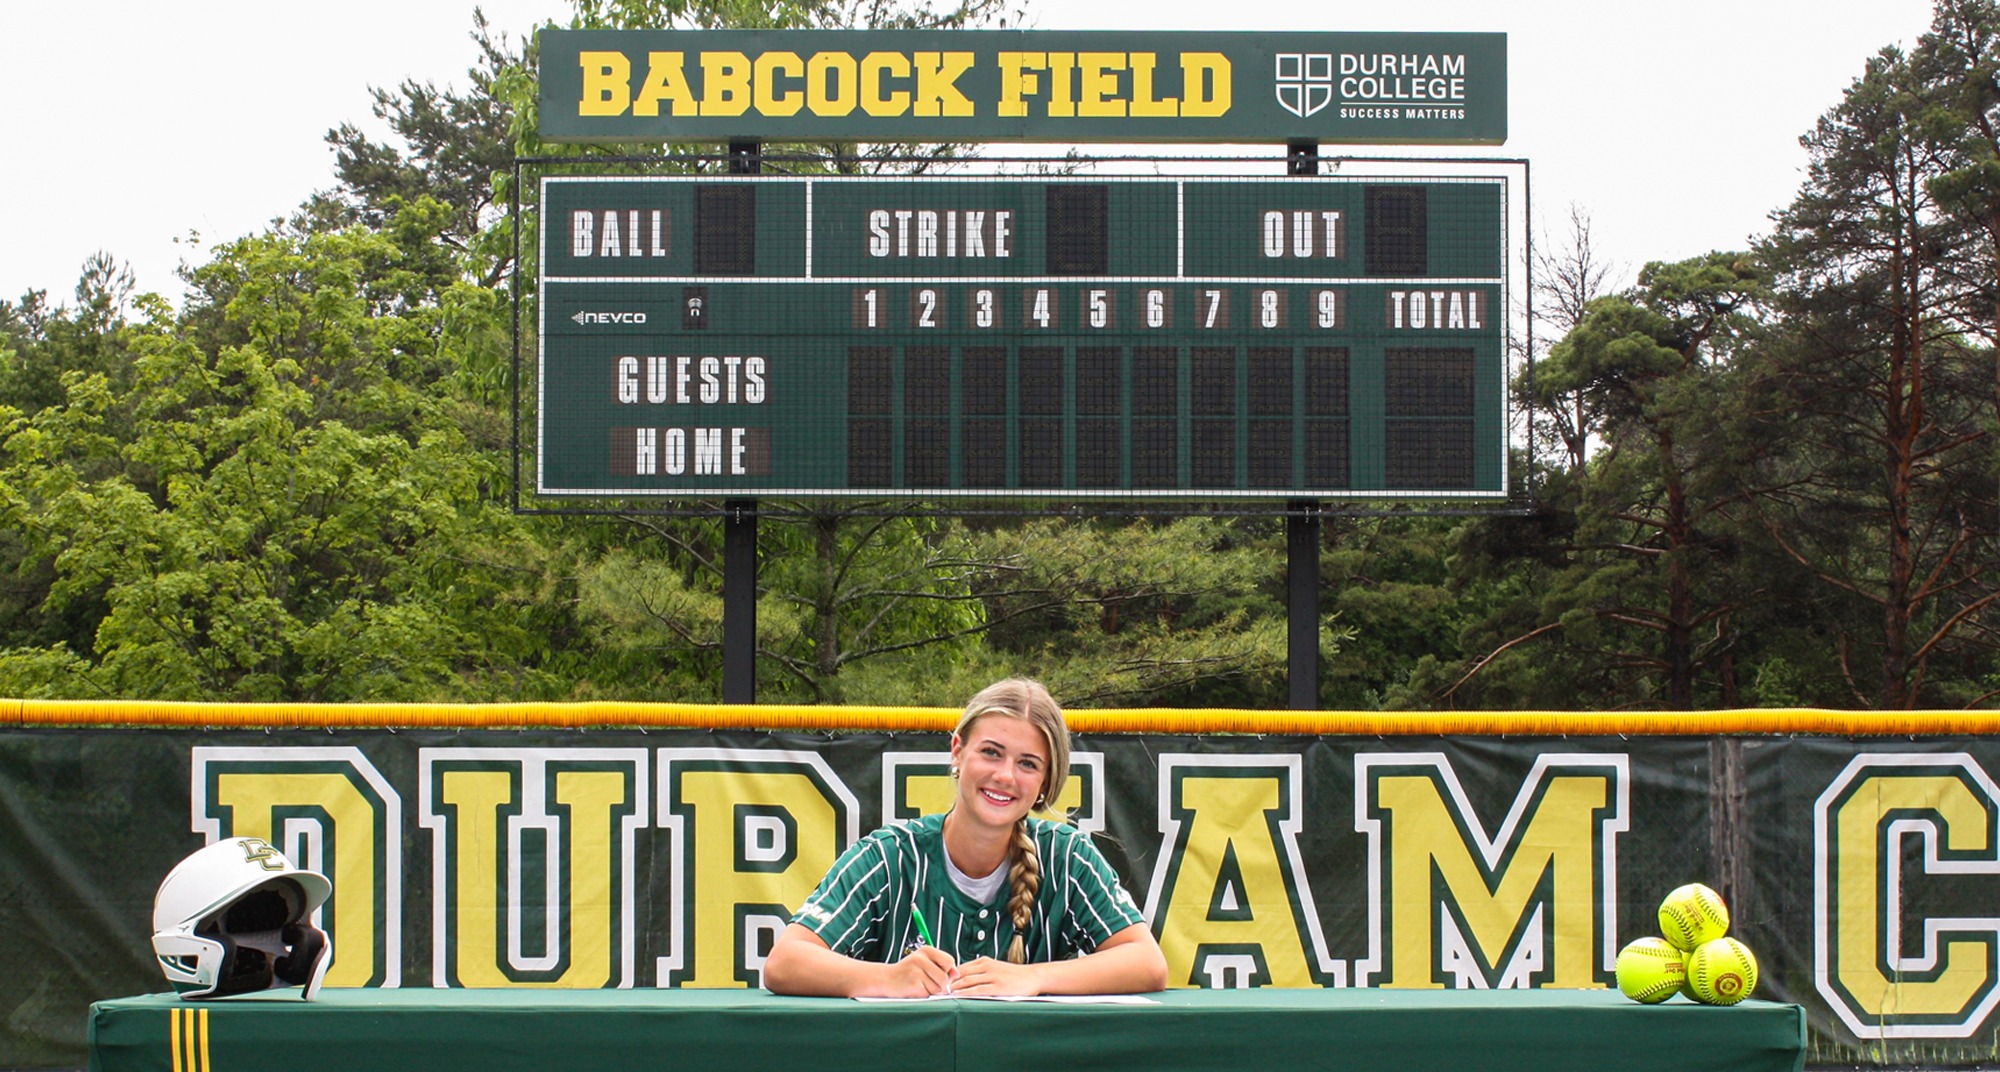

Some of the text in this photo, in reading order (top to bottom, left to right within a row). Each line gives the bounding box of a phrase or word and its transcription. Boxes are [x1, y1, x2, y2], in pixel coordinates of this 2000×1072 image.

[579, 51, 1232, 117] BABCOCK FIELD
[1340, 53, 1465, 76] DURHAM
[1340, 77, 1465, 99] COLLEGE
[1340, 108, 1465, 119] SUCCESS MATTERS
[573, 210, 666, 257] BALL
[869, 210, 1011, 257] STRIKE
[1263, 211, 1340, 258] OUT
[864, 289, 1481, 329] 1 2 3 4 5 6 7 8 9 TOTAL
[618, 356, 766, 404] GUESTS
[636, 428, 746, 475] HOME
[192, 746, 1629, 990] DURAM
